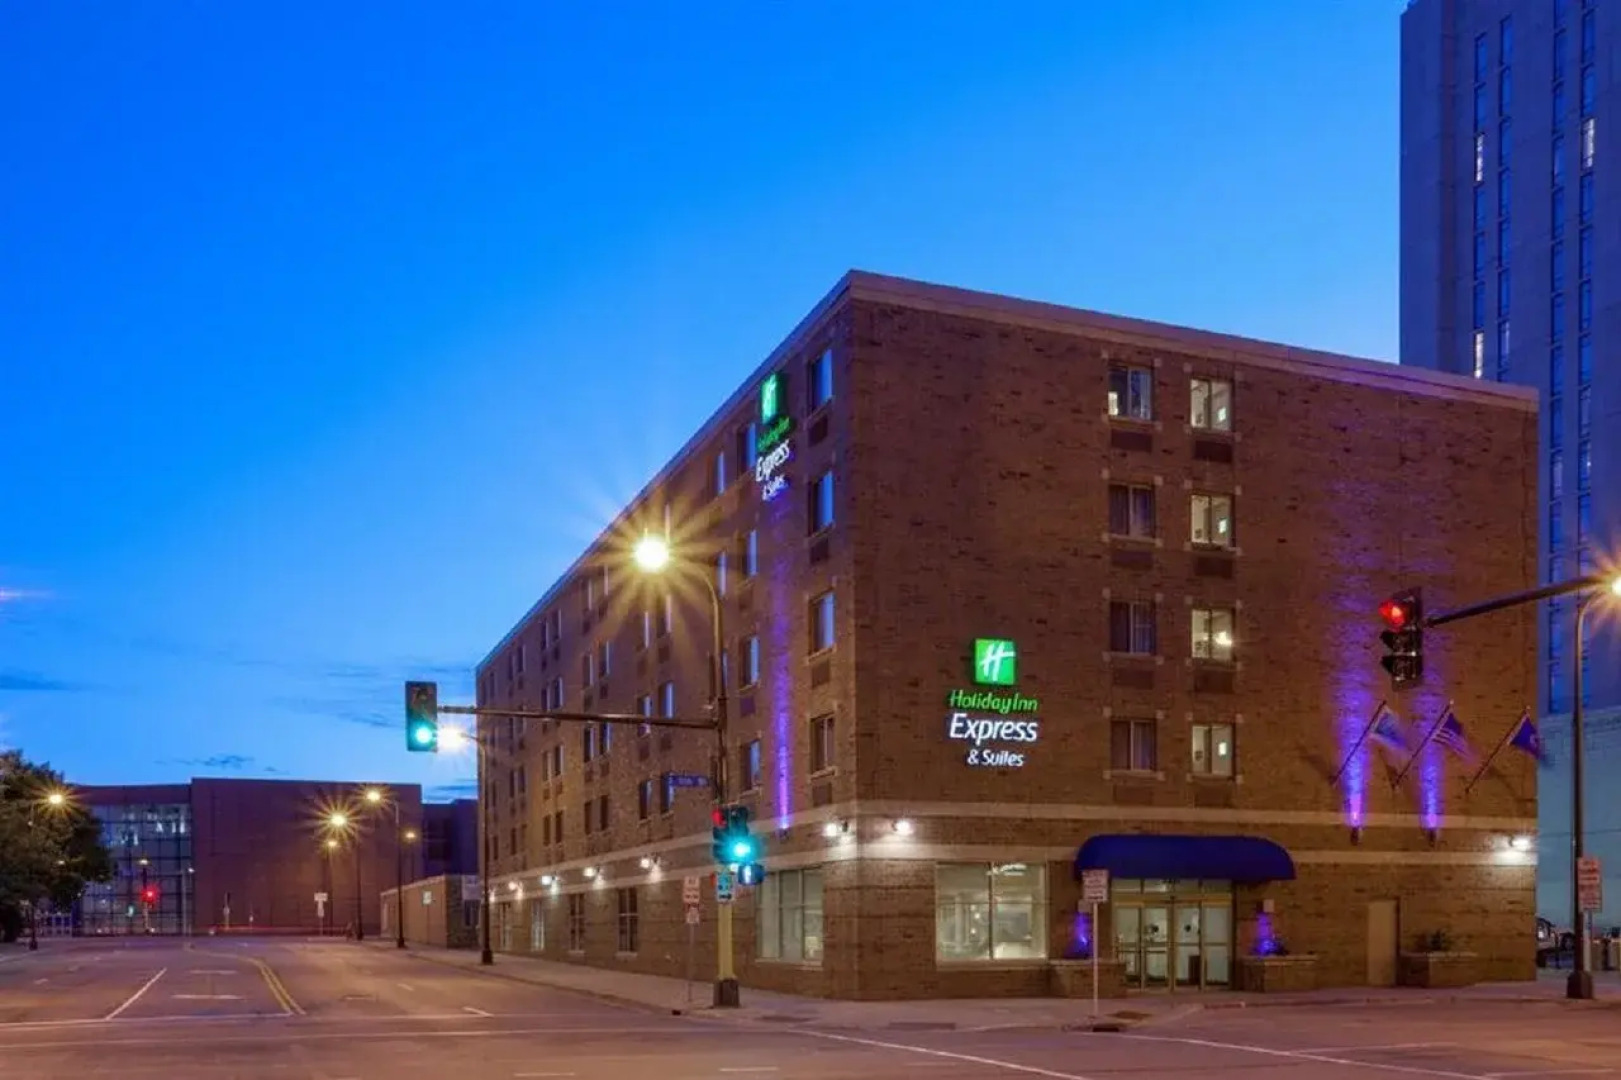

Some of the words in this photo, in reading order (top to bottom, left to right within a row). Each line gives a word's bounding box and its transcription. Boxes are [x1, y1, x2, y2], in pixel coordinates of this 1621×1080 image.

[950, 689, 1012, 714] Holiday
[1012, 693, 1038, 711] Inn
[949, 712, 1038, 746] Express
[967, 749, 980, 765] &
